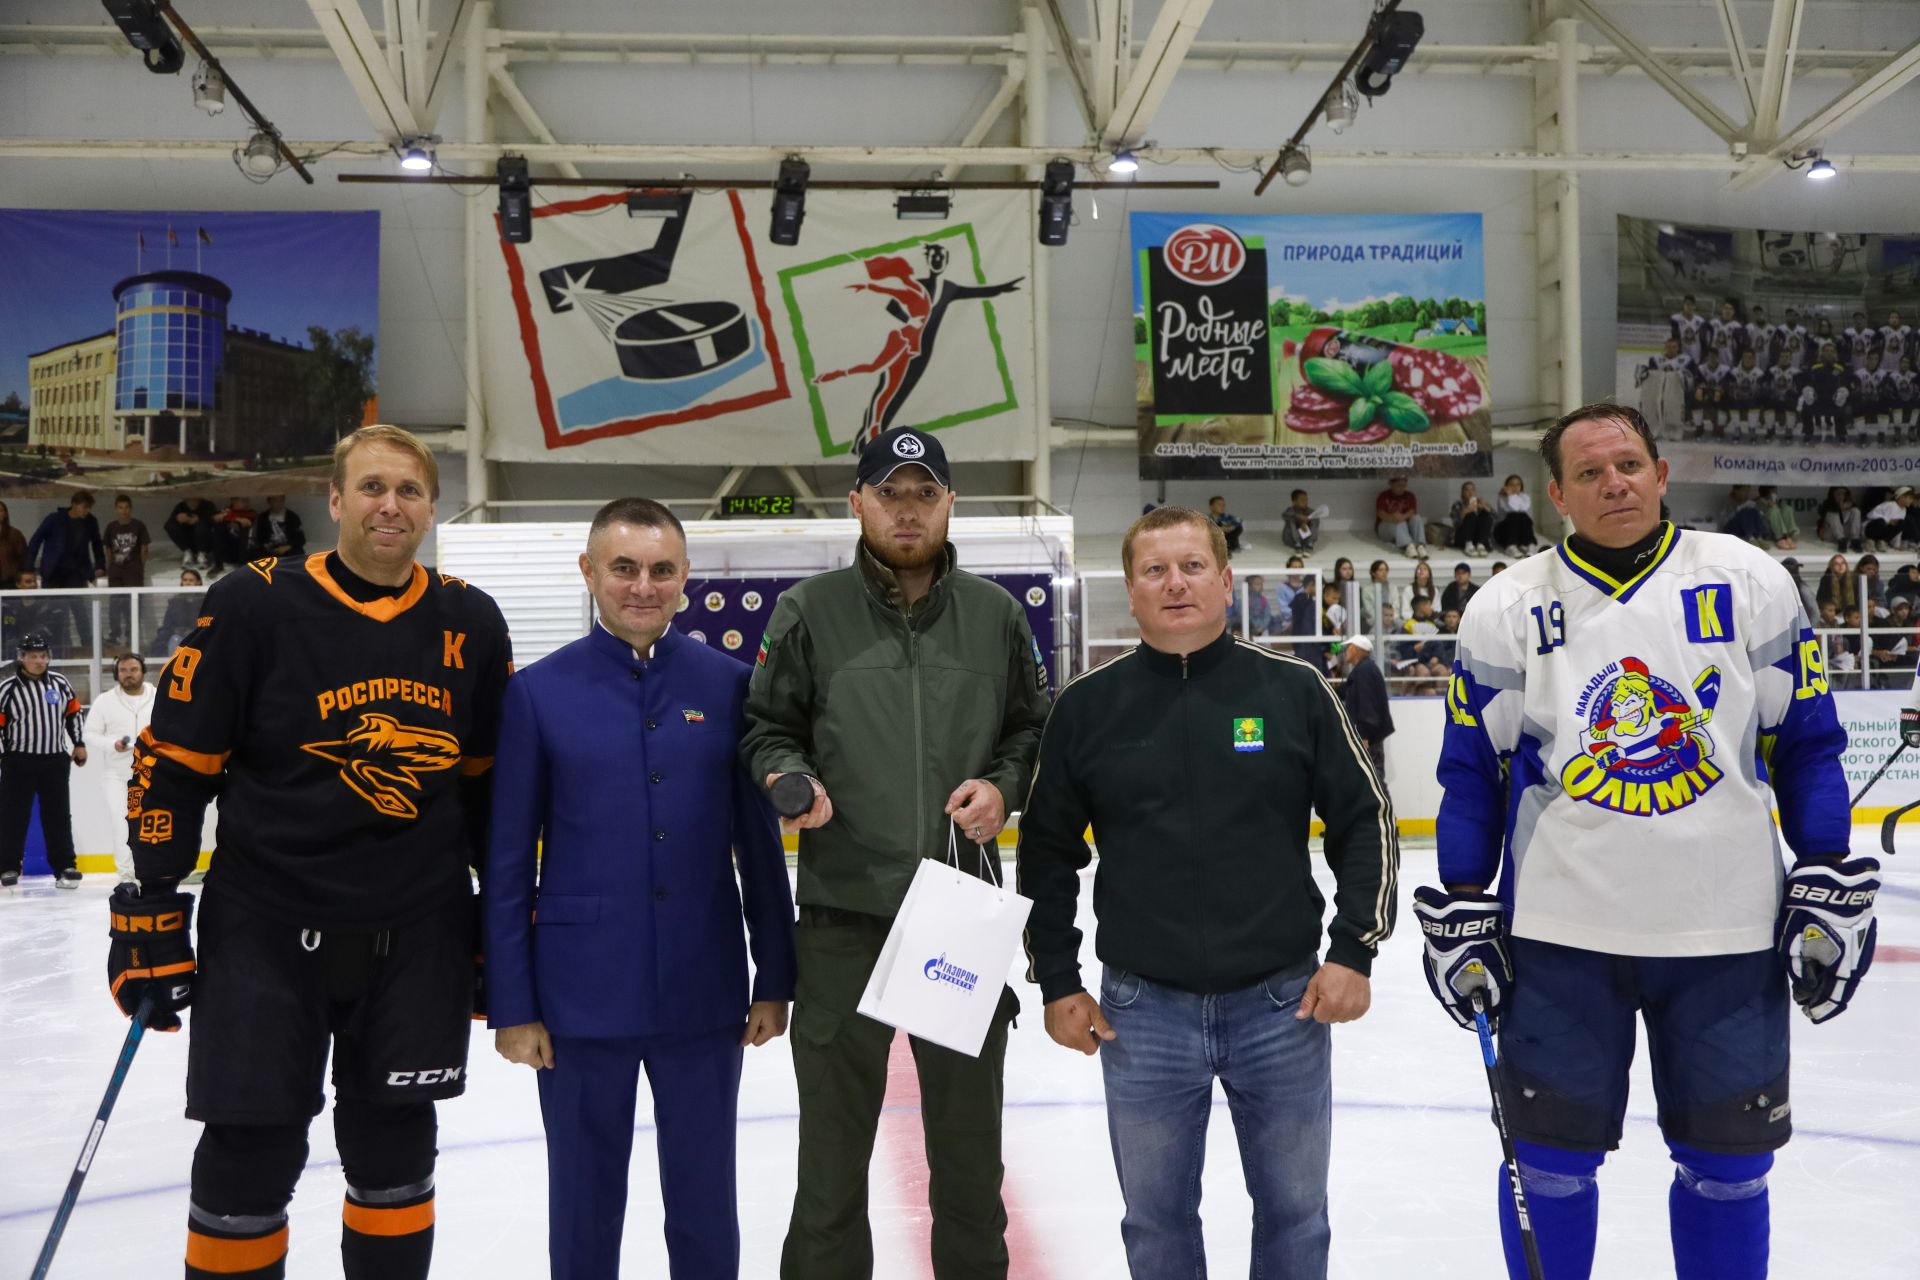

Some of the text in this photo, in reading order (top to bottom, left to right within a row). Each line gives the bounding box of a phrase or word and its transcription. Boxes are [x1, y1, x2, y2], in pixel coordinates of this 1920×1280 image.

[1284, 239, 1463, 262] ПРИРОДА ТРАДИЦИЙ
[1157, 295, 1266, 363] Родные
[1166, 345, 1254, 390] места
[1199, 444, 1260, 456] Республика
[1714, 455, 1785, 472] Команда
[1531, 601, 1567, 656] 19
[1575, 661, 1618, 718] МАМАДЫШ
[1795, 639, 1829, 700] 19
[317, 677, 452, 720] РОСПРЕССА
[1562, 752, 1725, 817] ОЛИМП
[143, 814, 170, 833] 92
[943, 962, 979, 985] ГАЗПРОМ
[387, 1066, 462, 1086] CCM
[1507, 1158, 1531, 1232] TRUE
